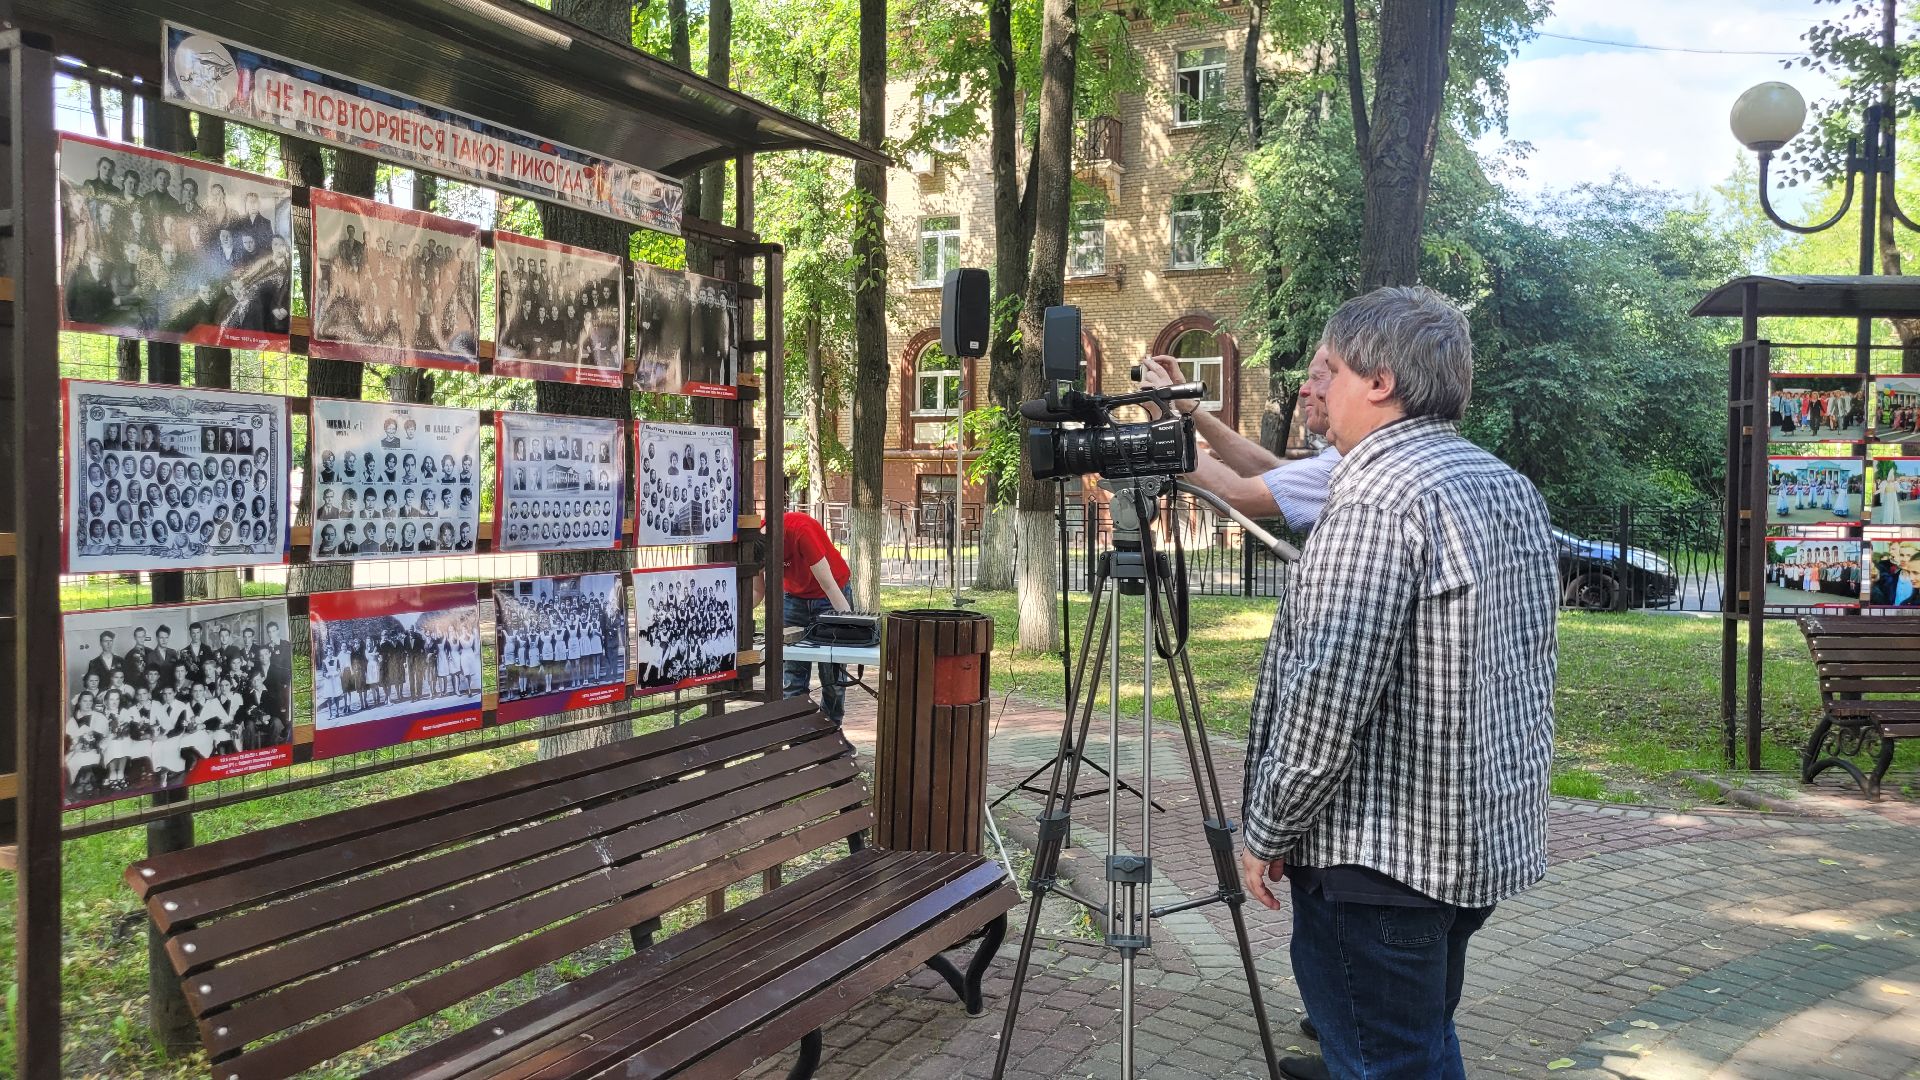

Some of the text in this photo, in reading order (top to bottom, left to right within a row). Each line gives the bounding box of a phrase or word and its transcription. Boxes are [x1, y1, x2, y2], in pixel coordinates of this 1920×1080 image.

[266, 78, 583, 194] НЕ ПОВТОРЯЕТСЯ ТАКОЕ НИКОГДА
